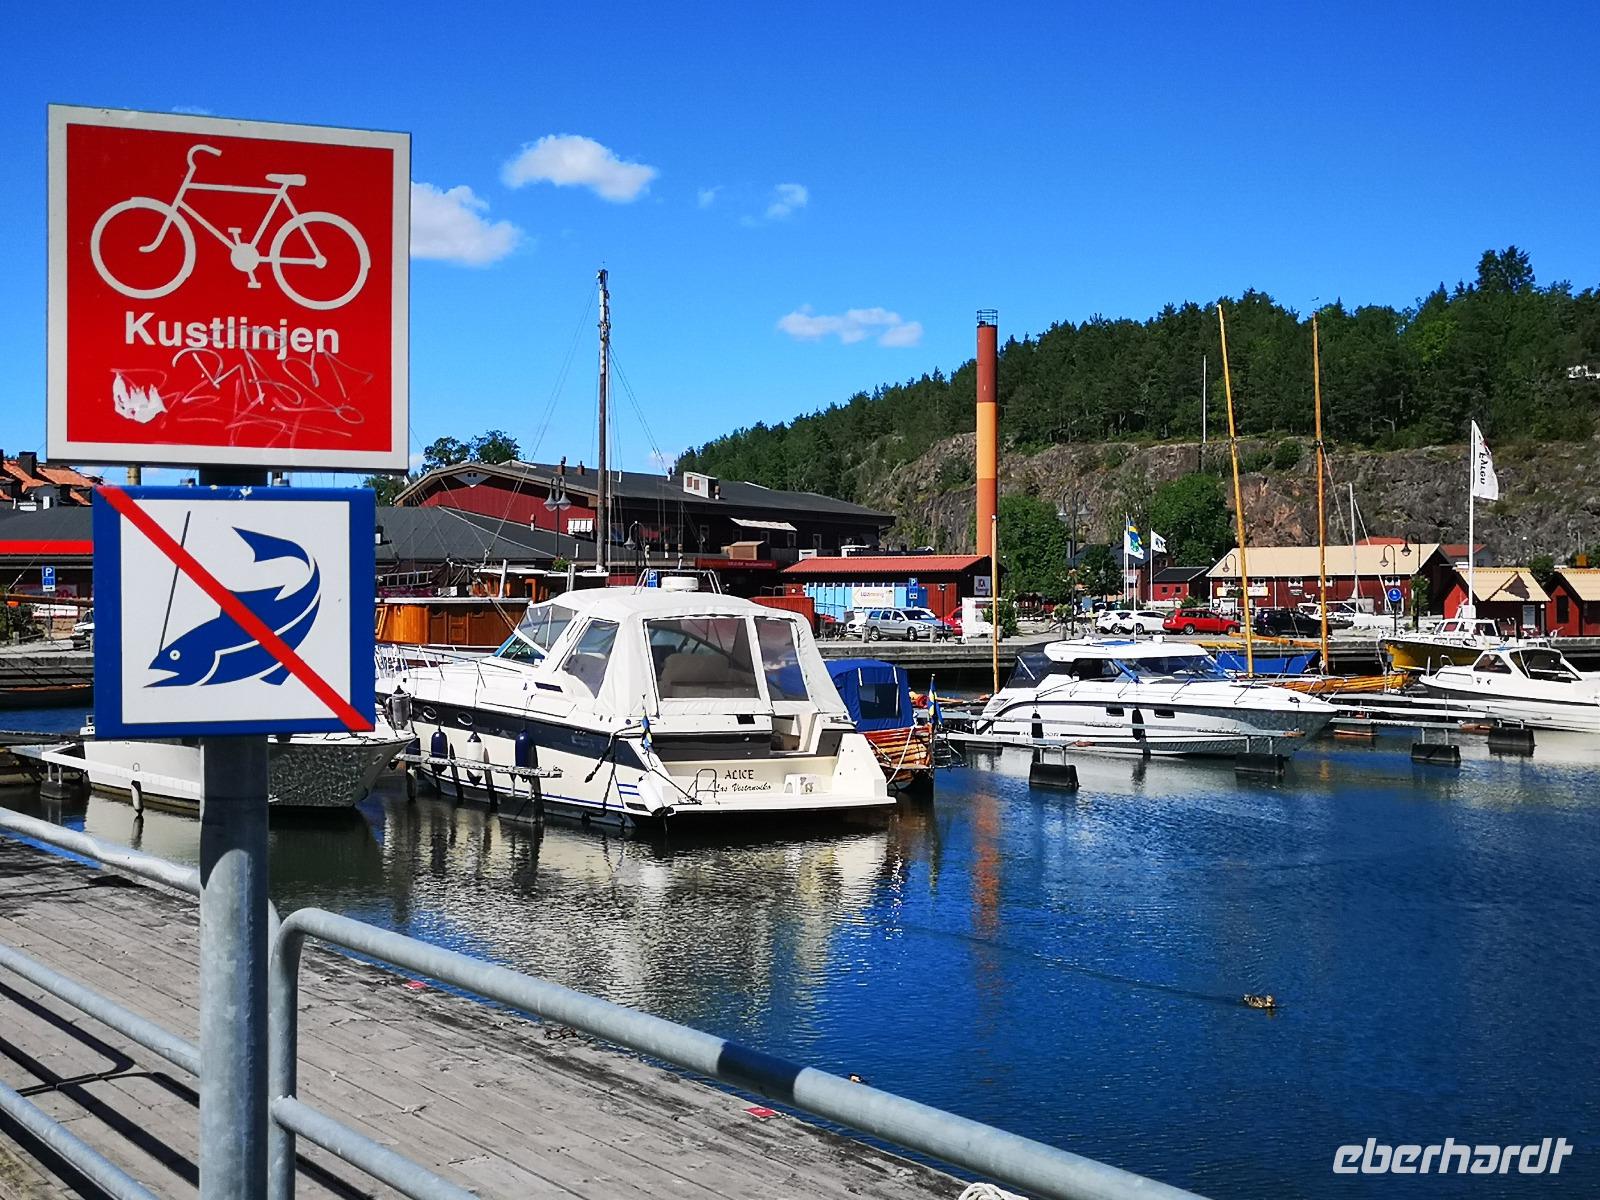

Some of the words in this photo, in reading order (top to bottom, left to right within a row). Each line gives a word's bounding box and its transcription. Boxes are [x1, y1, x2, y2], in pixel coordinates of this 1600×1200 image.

[125, 311, 339, 360] Kustlinjen
[45, 567, 53, 577] P
[724, 769, 754, 780] ALICE
